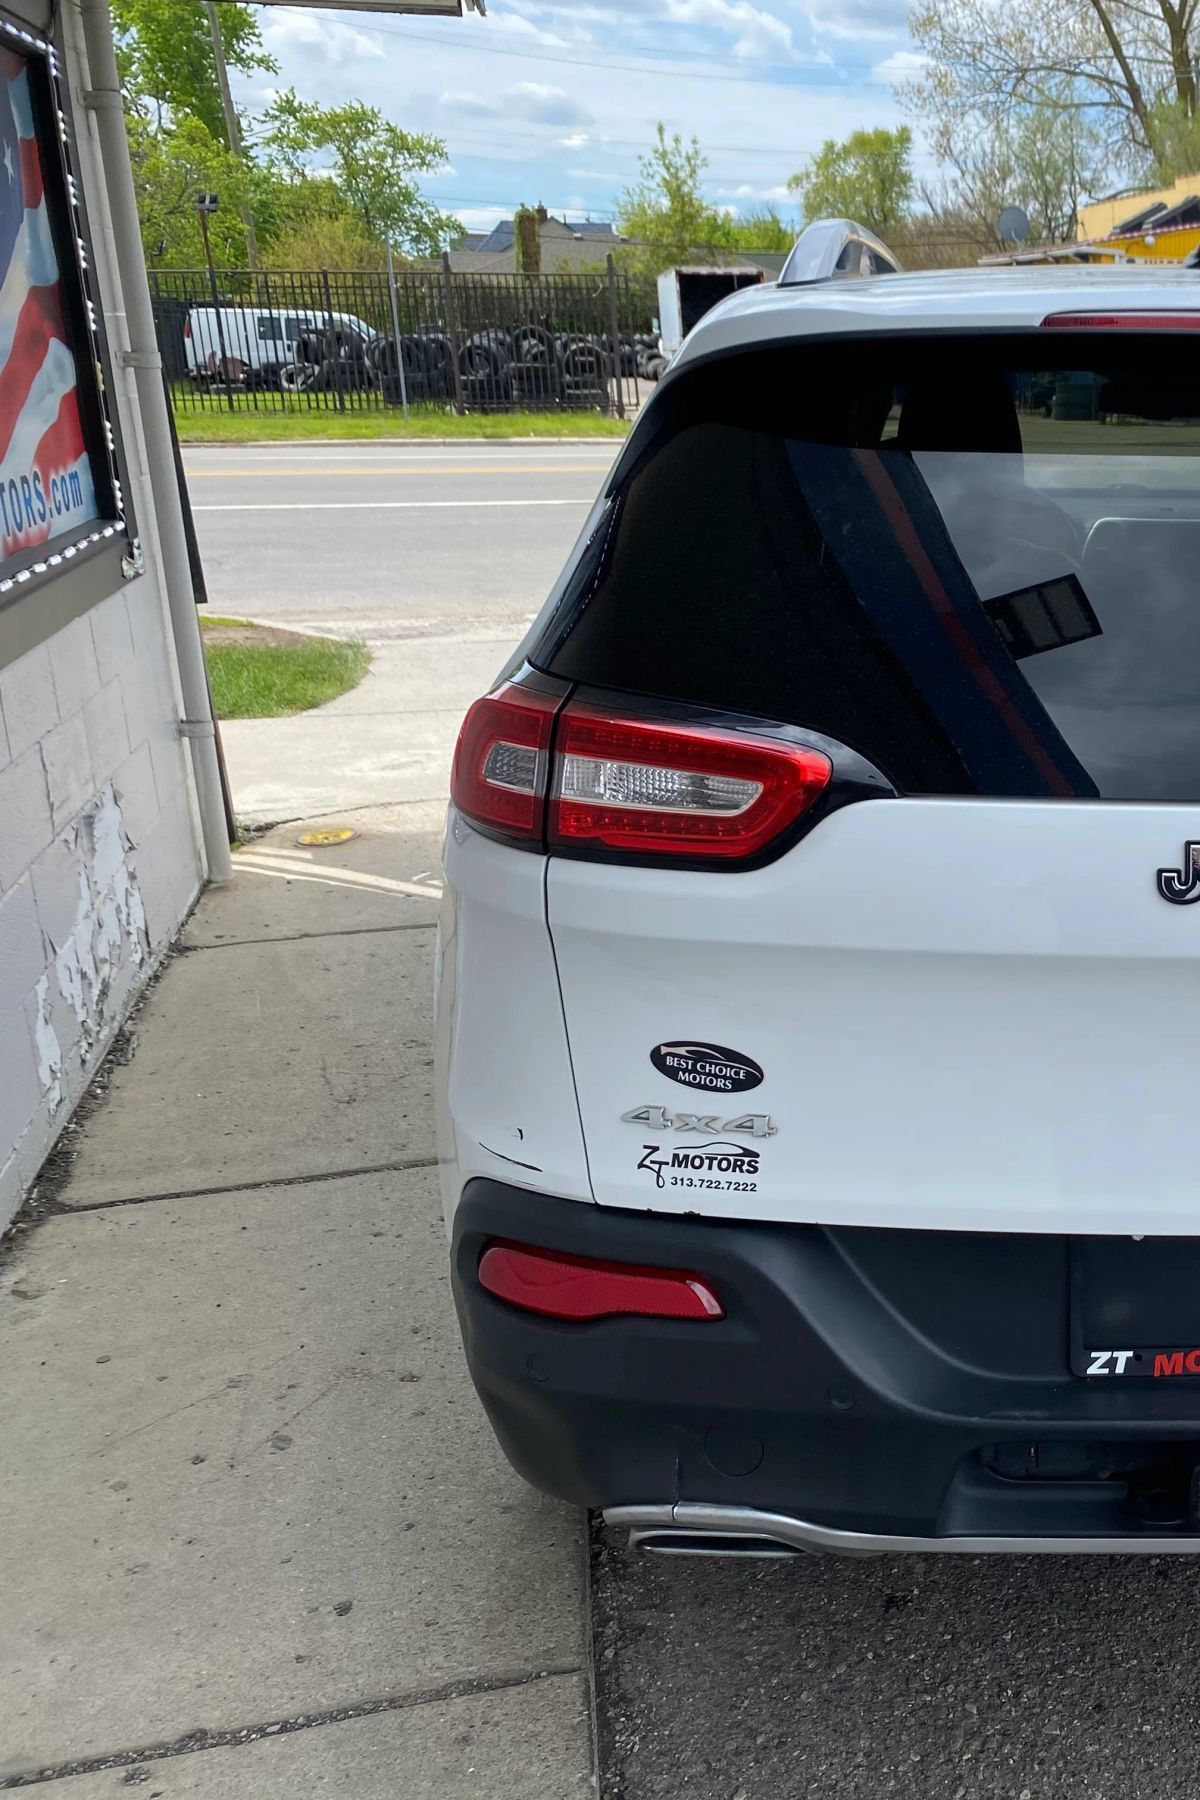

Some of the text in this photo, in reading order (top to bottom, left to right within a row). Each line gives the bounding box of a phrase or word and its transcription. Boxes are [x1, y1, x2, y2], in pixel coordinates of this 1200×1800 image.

[666, 1056, 747, 1080] BEST CHOICE
[677, 1071, 733, 1090] MOTORS
[670, 1153, 760, 1175] MOTORS
[670, 1176, 757, 1192] 313.722.7222
[1086, 1350, 1134, 1375] ZT
